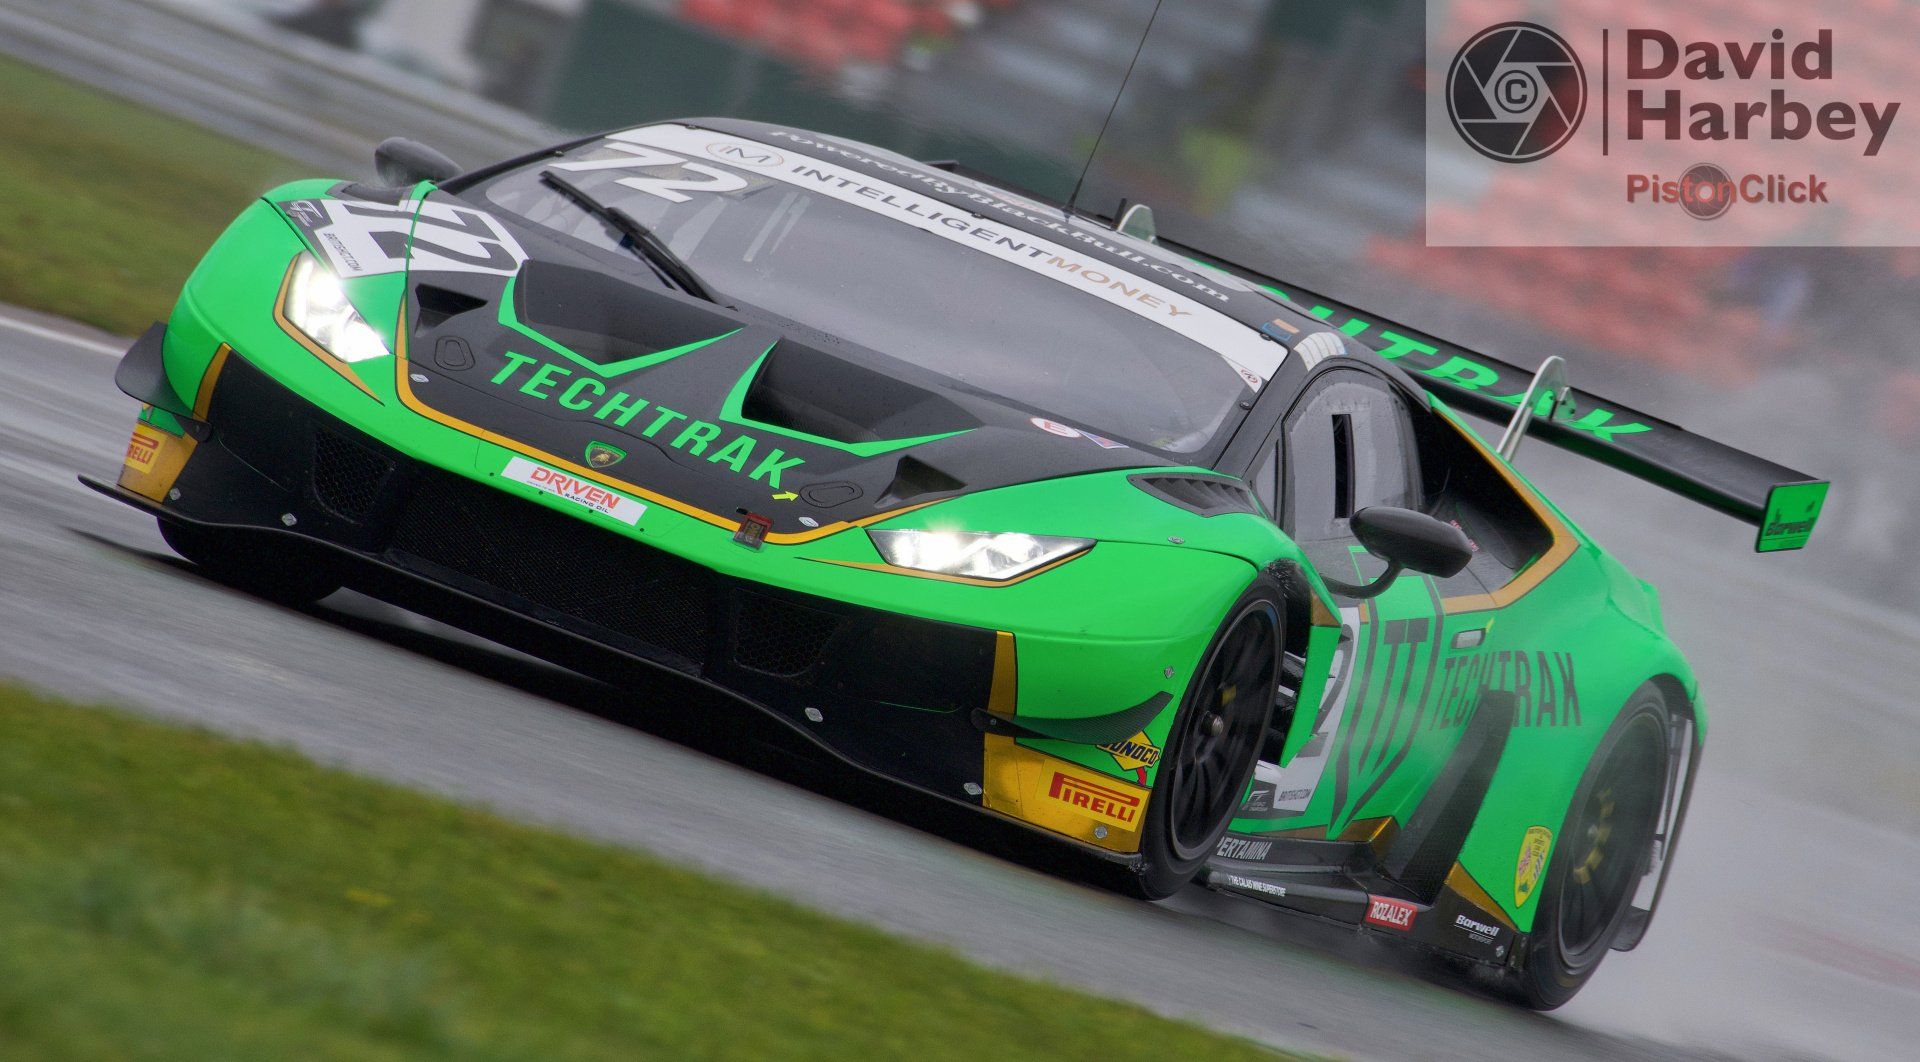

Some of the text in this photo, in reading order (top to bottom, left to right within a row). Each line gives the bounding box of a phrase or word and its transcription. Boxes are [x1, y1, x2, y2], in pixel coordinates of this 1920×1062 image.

[548, 142, 749, 203] 72
[768, 130, 1230, 301] PoweredByBlackBull.com
[490, 351, 806, 490] TECHTRAK
[530, 466, 621, 510] DRIVEN
[564, 492, 609, 514] RACING OIL
[1429, 650, 1582, 731] TECHTRAK
[1048, 771, 1140, 823] PIRELLI
[1370, 901, 1413, 926] ROZALEX
[1455, 914, 1500, 937] Barwell
